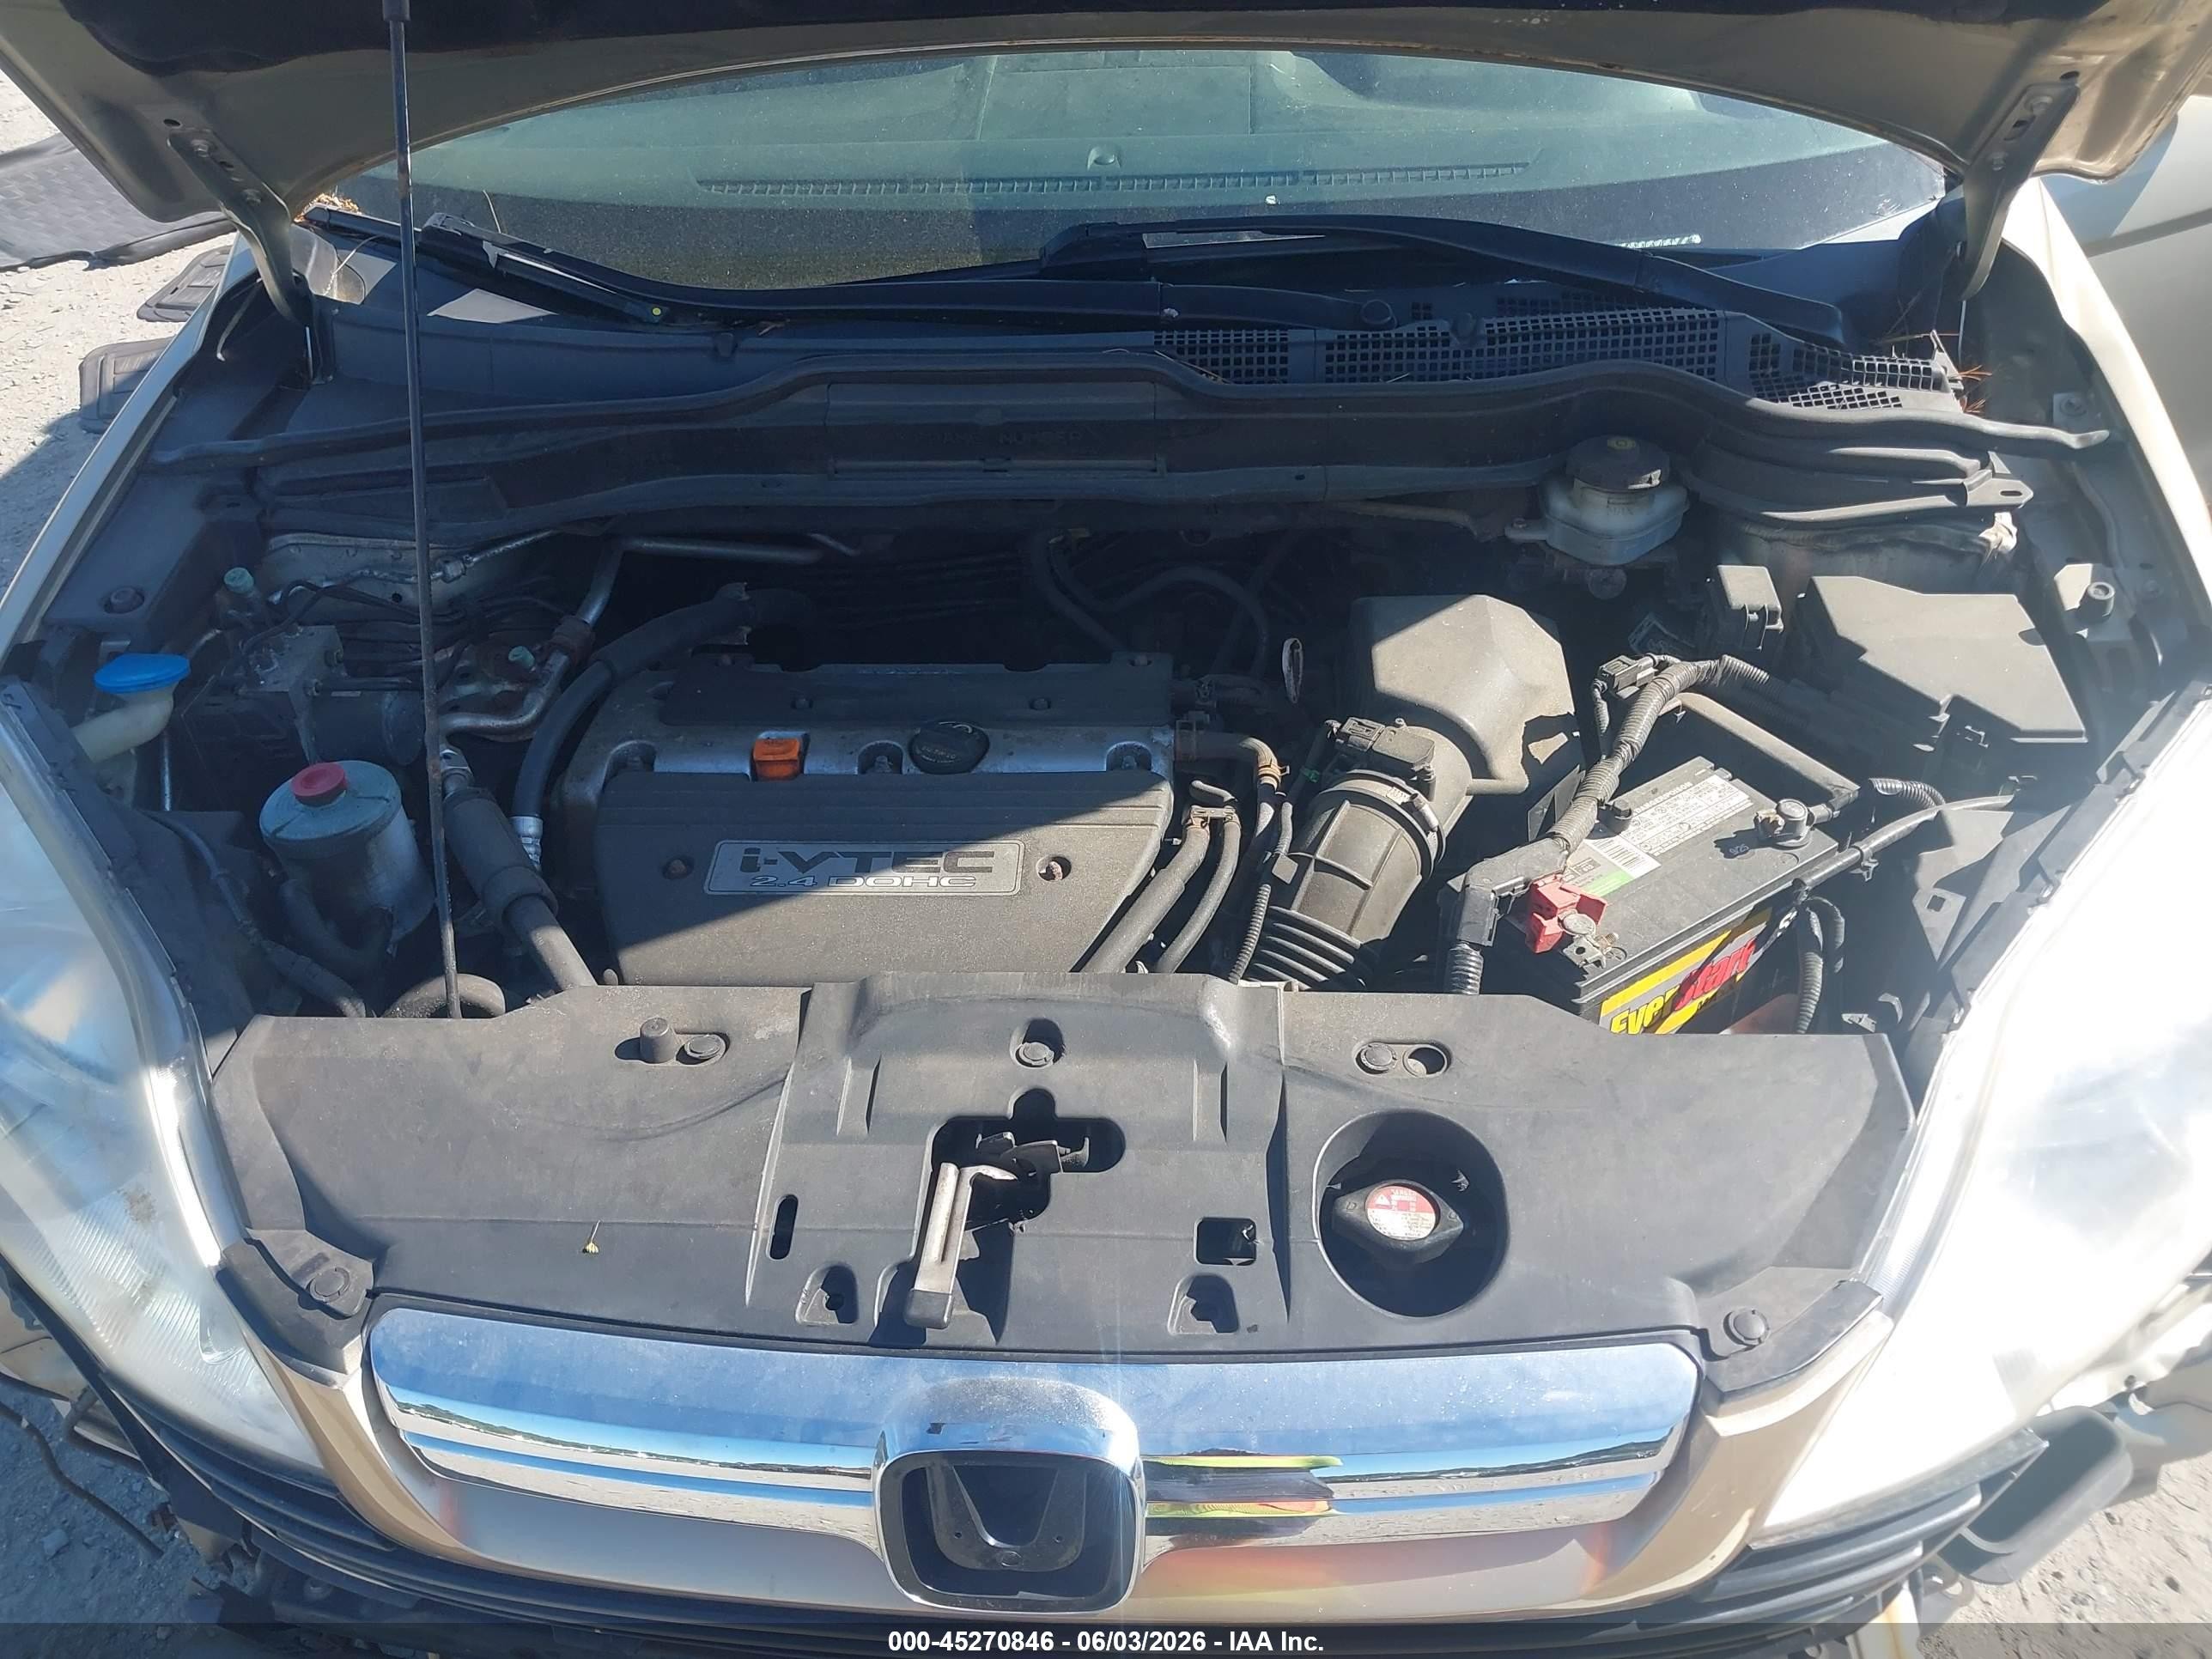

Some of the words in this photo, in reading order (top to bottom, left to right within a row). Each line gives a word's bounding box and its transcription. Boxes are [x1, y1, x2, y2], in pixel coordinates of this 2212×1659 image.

[740, 847, 994, 874] i-VTEC
[750, 875, 817, 887] 2.4
[827, 875, 976, 888] DOHC
